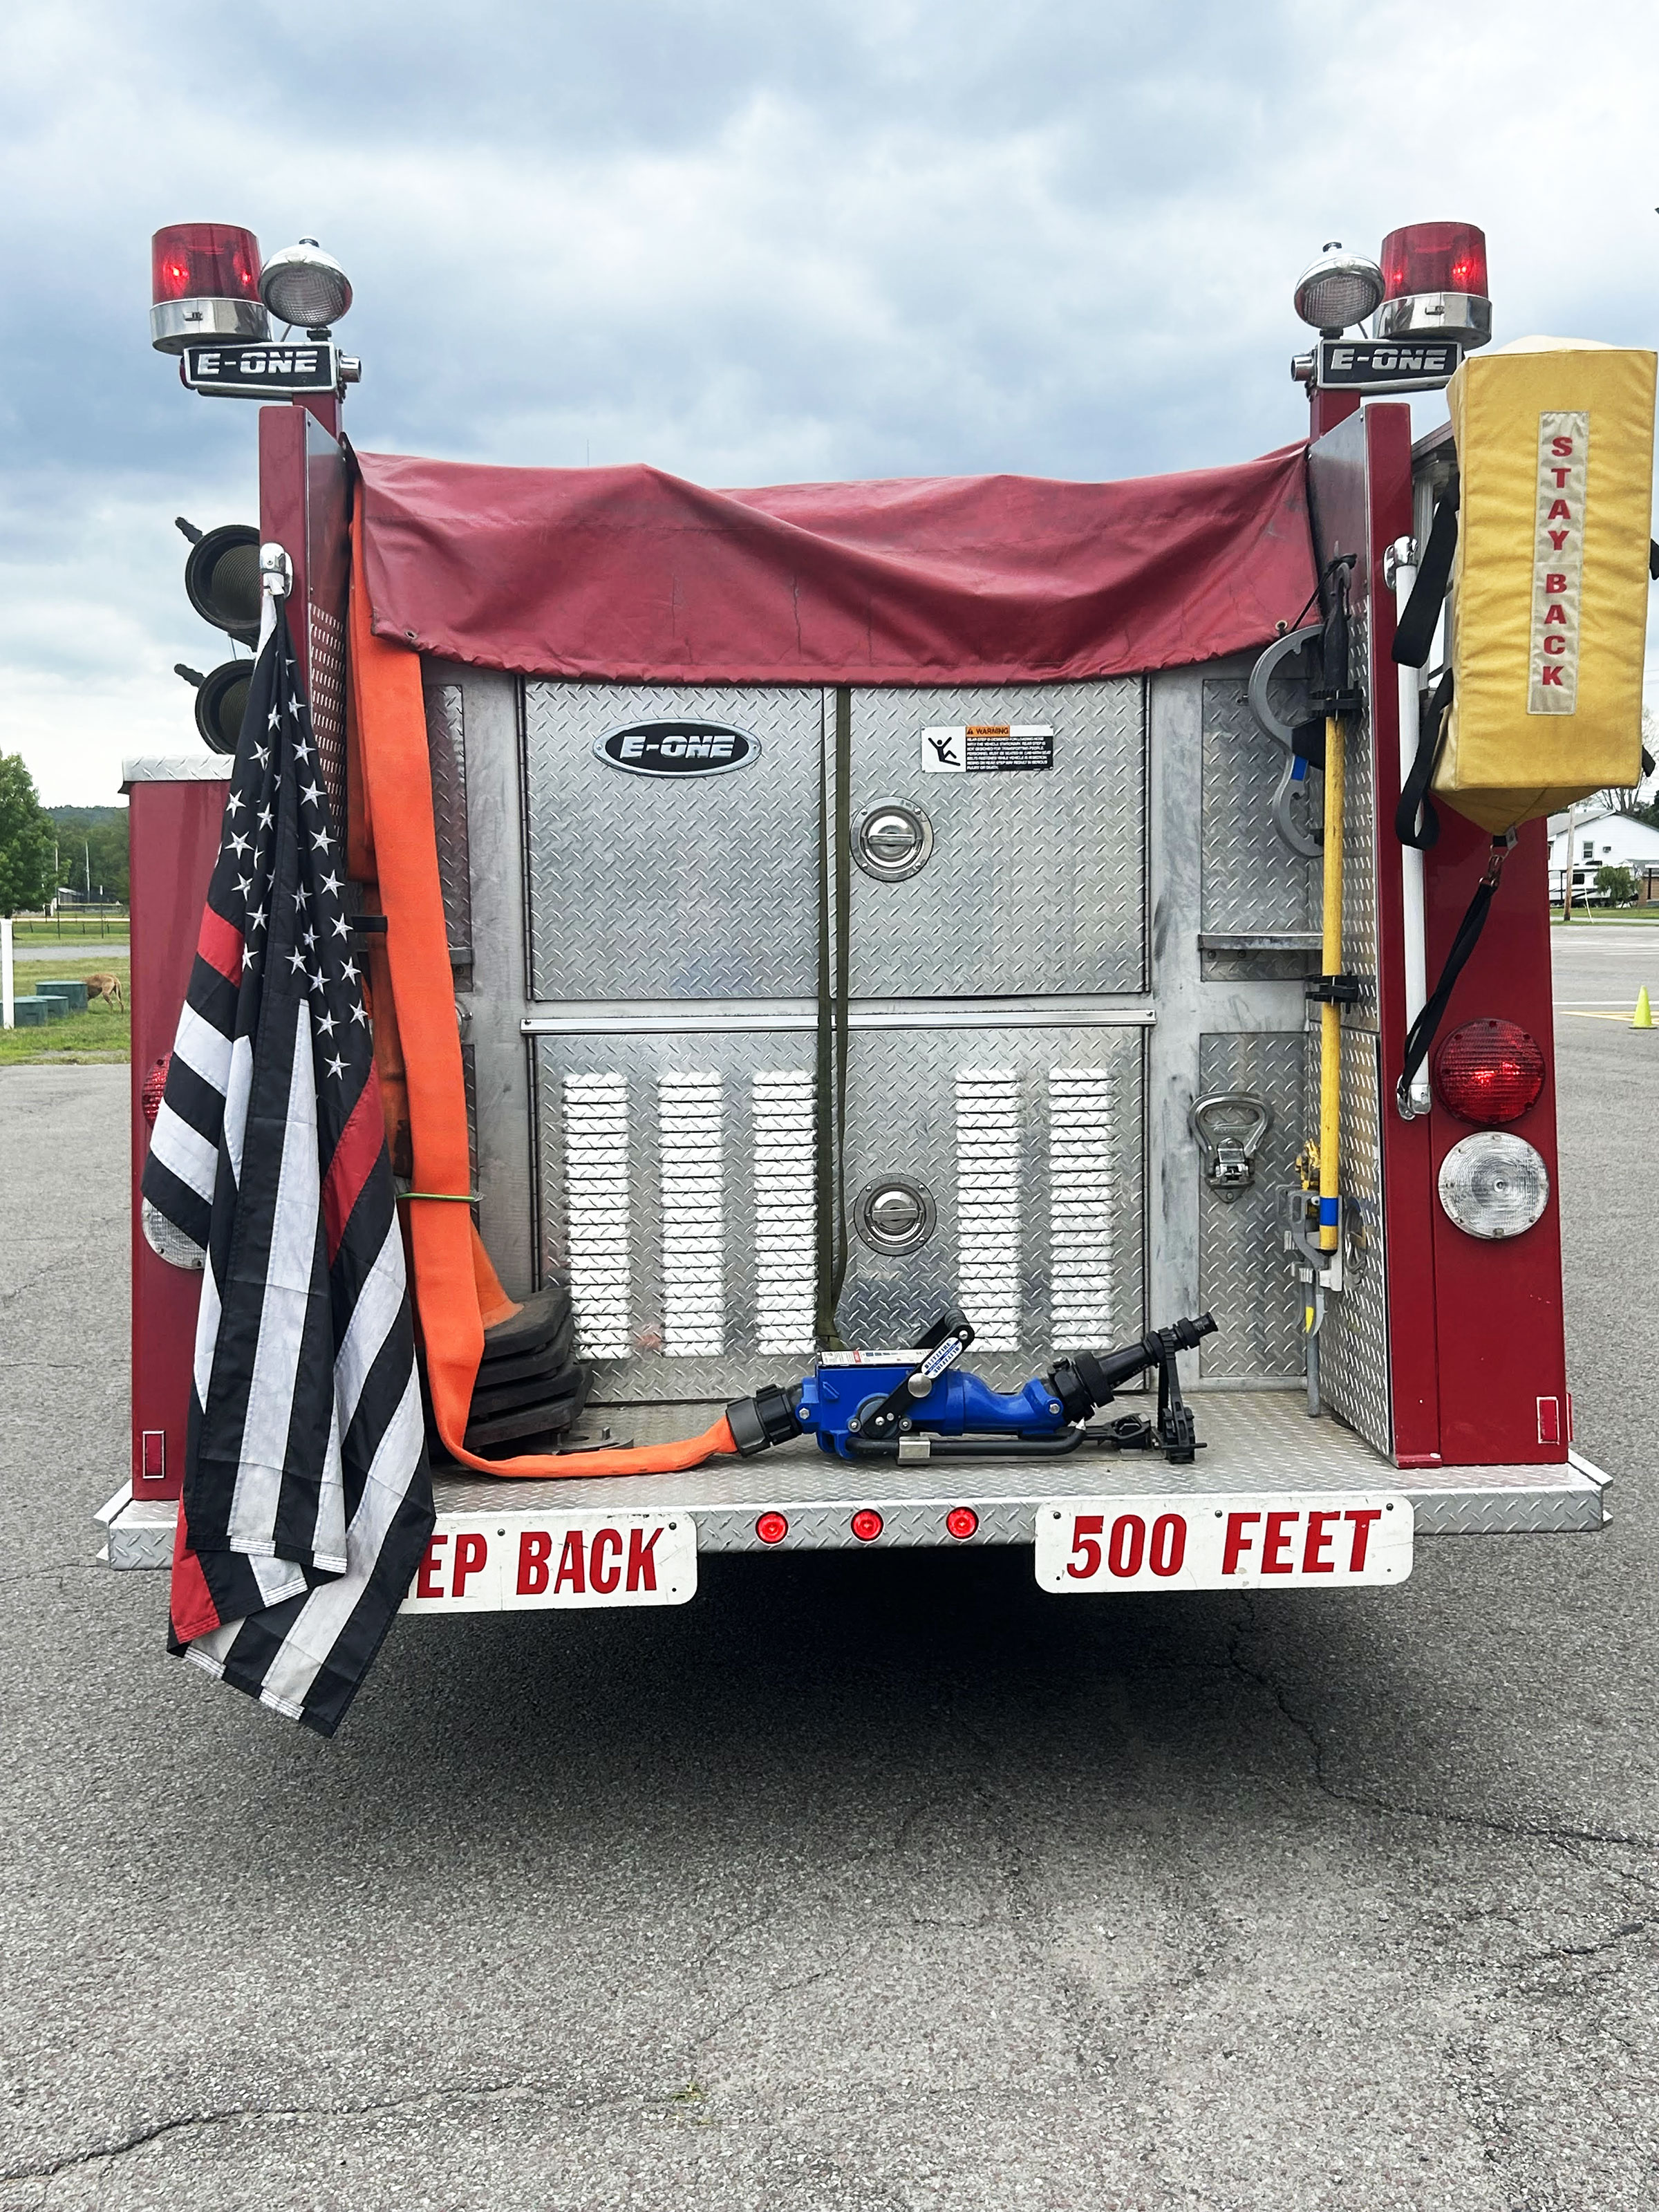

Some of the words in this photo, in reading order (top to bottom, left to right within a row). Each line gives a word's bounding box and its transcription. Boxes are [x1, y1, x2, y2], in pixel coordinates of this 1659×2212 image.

[197, 350, 318, 375] E-ONE
[1331, 348, 1447, 371] E-ONE
[1547, 436, 1573, 551] STAY
[1541, 573, 1568, 686] BACK
[619, 735, 735, 759] E-ONE
[403, 1533, 488, 1600] EP
[516, 1527, 665, 1595] BACK
[1067, 1512, 1187, 1580] 500
[1221, 1509, 1382, 1575] FEET
